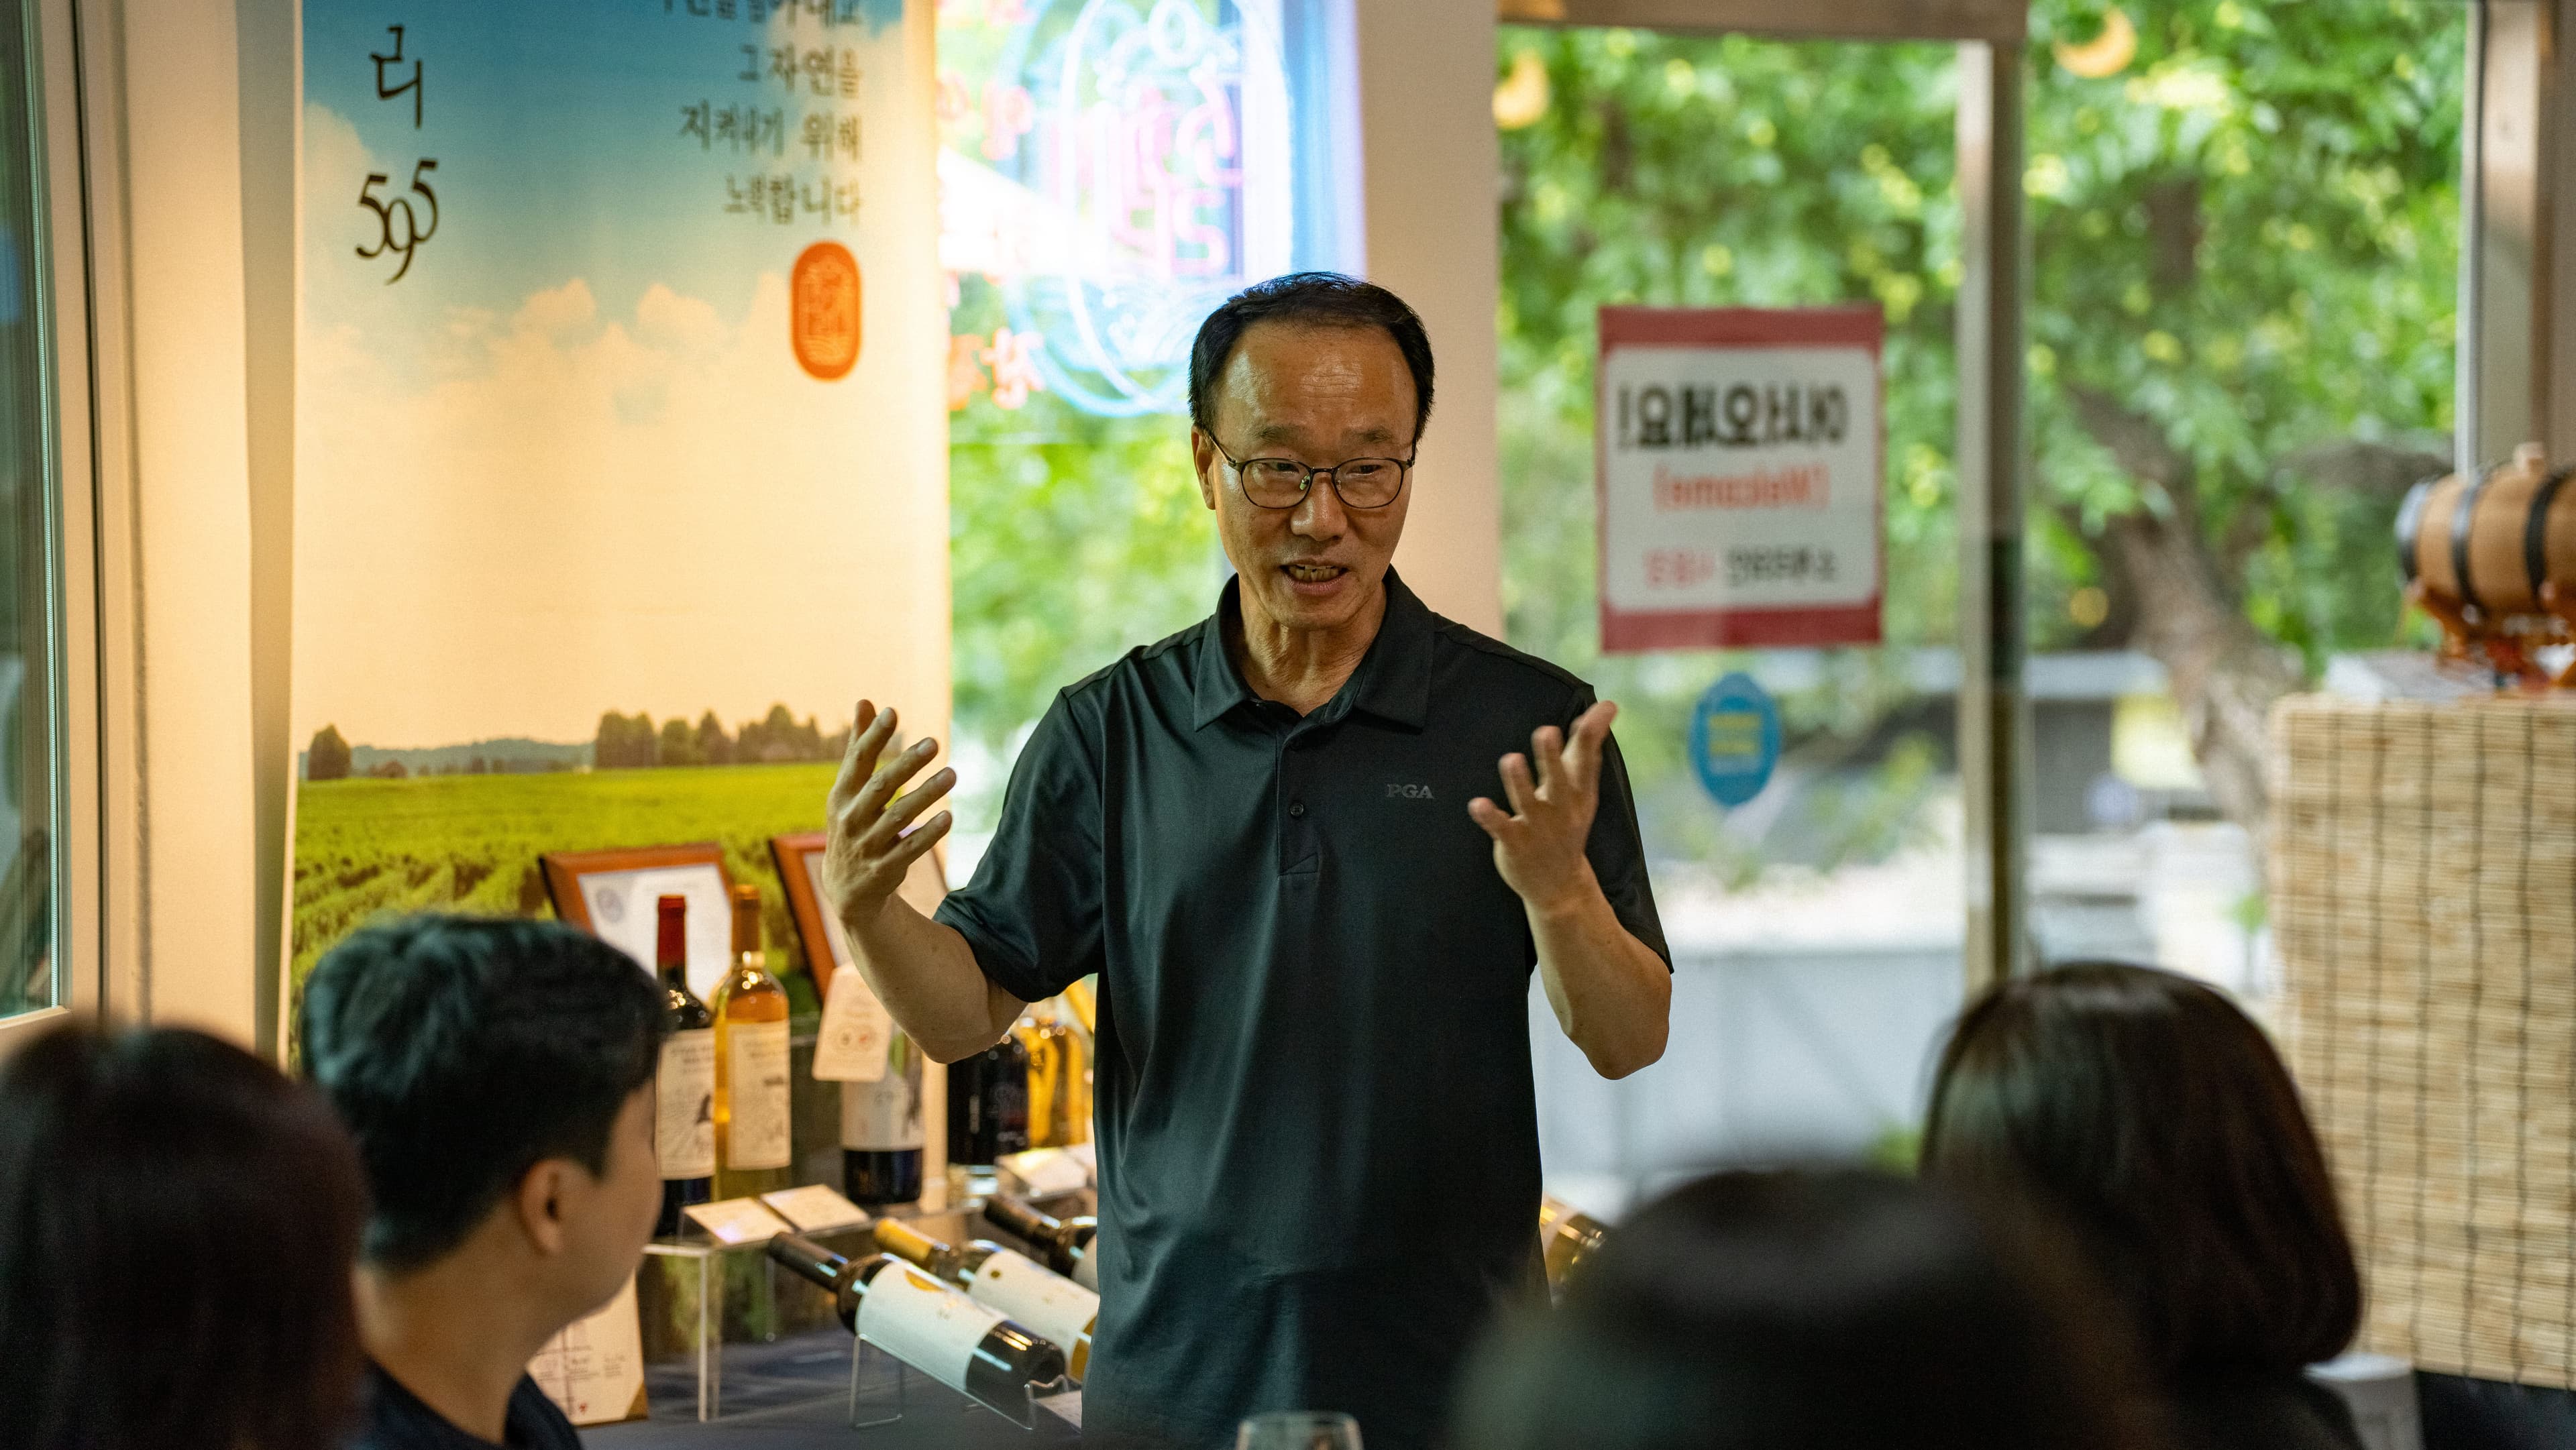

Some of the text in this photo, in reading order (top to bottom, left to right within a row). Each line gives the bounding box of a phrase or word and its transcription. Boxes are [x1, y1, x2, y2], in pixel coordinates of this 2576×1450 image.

[369, 24, 423, 129] 리
[355, 158, 439, 286] 595
[1386, 783, 1434, 799] PGA
